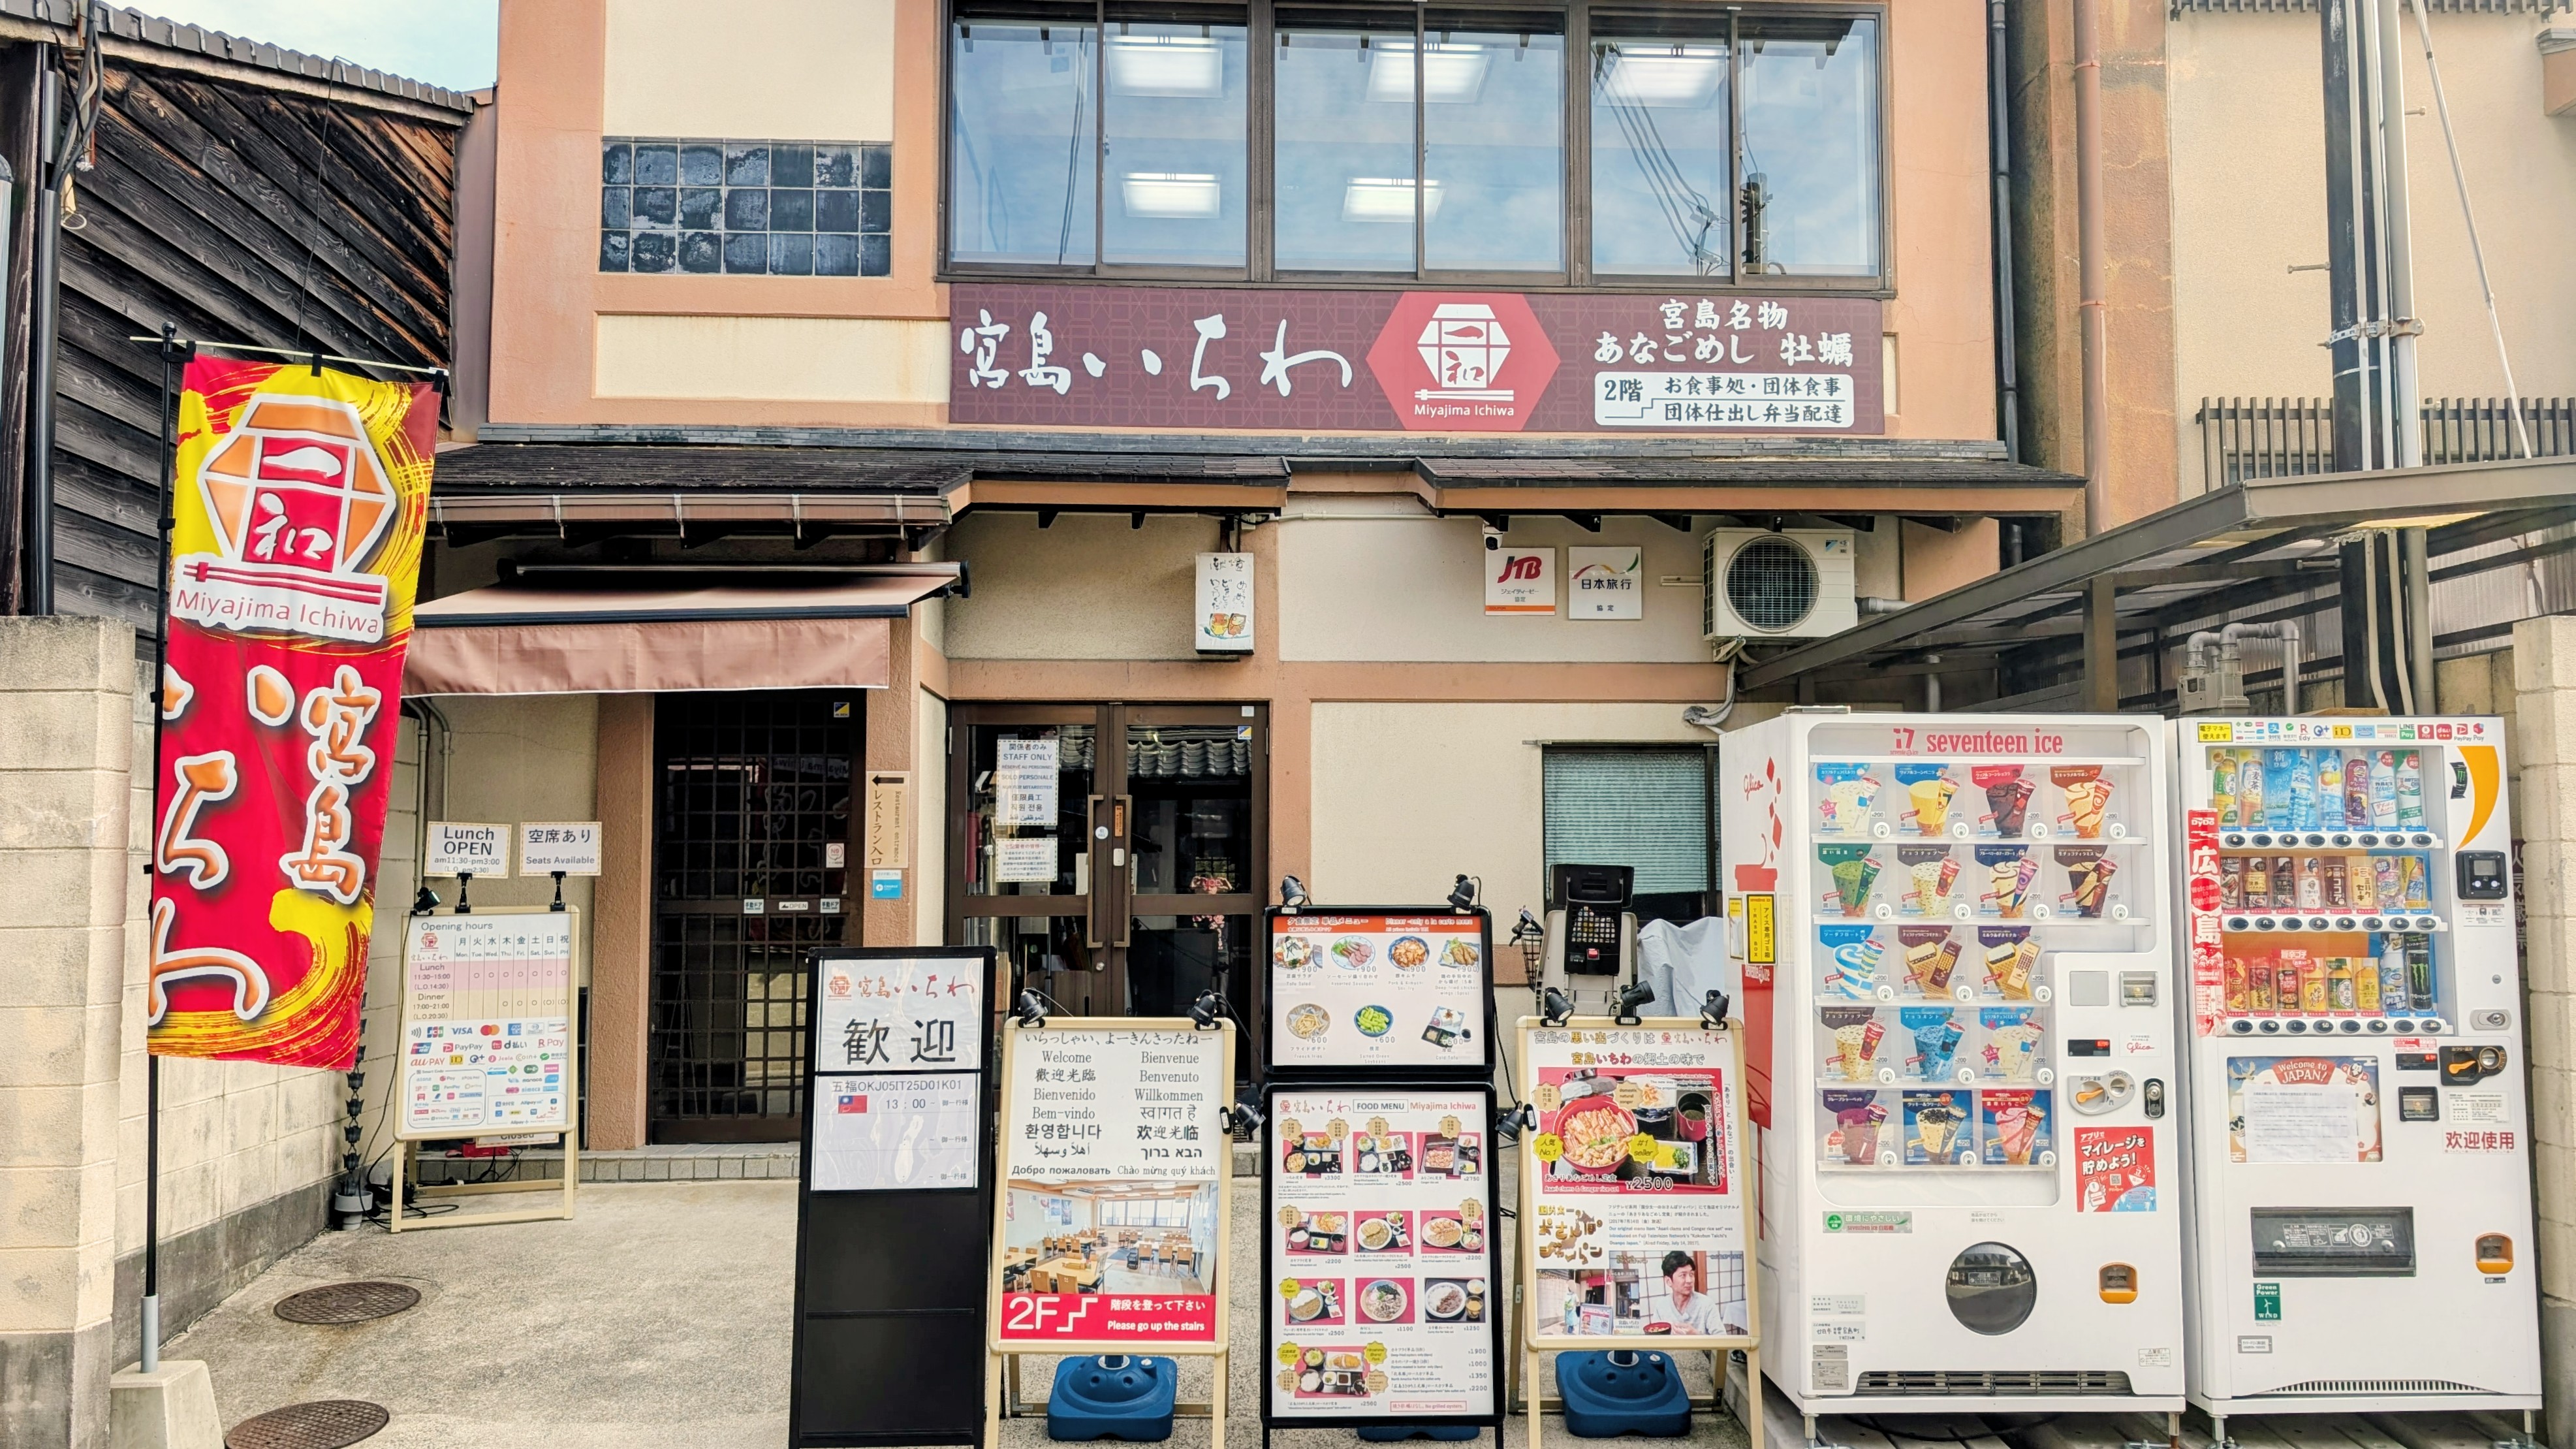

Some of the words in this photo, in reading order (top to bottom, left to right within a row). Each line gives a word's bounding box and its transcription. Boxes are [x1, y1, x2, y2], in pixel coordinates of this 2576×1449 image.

[1659, 299, 1789, 330] 宮島名物
[1595, 332, 1755, 364] あなごめし
[1780, 332, 1854, 366] 牡蠣
[1603, 379, 1643, 402] 2階
[1665, 377, 1842, 396] お食事処・団体食事
[1415, 405, 1470, 417] Miyajima
[1475, 404, 1515, 416] Ichiwa
[1663, 403, 1844, 423] 団体仕出し弁当配達
[1498, 556, 1542, 583] JTB
[1582, 579, 1632, 590] 日本旅行
[176, 589, 290, 621] Miyajima
[300, 603, 379, 634] Ichiwa
[1926, 730, 2027, 753] seventeen
[2035, 728, 2063, 754] ice
[1744, 773, 1763, 801] Glico
[870, 790, 883, 865] レストラン入口
[2191, 818, 2214, 826] DyDo
[444, 826, 494, 840] Lunch
[528, 829, 591, 843] 空席あり
[444, 841, 492, 855] OPEN
[421, 922, 462, 932] Opening
[465, 921, 493, 931] hours
[473, 937, 482, 946] 火
[488, 936, 497, 945] 水
[502, 936, 511, 945] 木
[517, 936, 526, 944] 金
[531, 936, 541, 944] 土
[547, 1038, 564, 1047] Pay
[842, 1018, 956, 1065] 歓迎
[1534, 1030, 1656, 1045] 宮島の思い出づくりは
[455, 1043, 483, 1051] PayPay
[2127, 1042, 2155, 1053] Glico
[1042, 1051, 1092, 1063] Welcome
[1141, 1051, 1199, 1064] Bienvenue
[1571, 1051, 1706, 1066] 宮島いちわの郷土の味で
[2278, 1062, 2316, 1072] Welcome
[2317, 1062, 2327, 1071] to
[1035, 1068, 1096, 1083] 歡迎光臨
[1139, 1070, 1199, 1083] Benvenuto
[2282, 1069, 2328, 1084] JAPAN!
[1033, 1088, 1096, 1100] Bienvenido
[1135, 1089, 1204, 1101] Willkommen
[1032, 1107, 1095, 1119] Bem-vindo
[1140, 1107, 1183, 1121] स्वागत
[1187, 1104, 1197, 1122] है
[1410, 1102, 1448, 1111] Miyajima
[1450, 1102, 1476, 1110] Ichiwa
[1025, 1123, 1102, 1140] 환영합니다
[1137, 1125, 1199, 1141] 欢迎光临
[2081, 1134, 2146, 1158] マイレージを
[2445, 1131, 2515, 1149] 欢迎使用
[1141, 1148, 1170, 1160] ברוך
[1175, 1149, 1202, 1158] הבא
[1012, 1165, 1045, 1176] Добро
[1049, 1166, 1111, 1175] пожаловать
[1117, 1165, 1140, 1175] Chào
[1170, 1165, 1187, 1177] quý
[1190, 1165, 1216, 1176] khách
[1845, 1214, 1900, 1222] 環境にやさしい
[1110, 1299, 1206, 1313] 階段を登って下さい
[1007, 1296, 1060, 1331] 2F
[1107, 1320, 1137, 1331] Please
[1137, 1322, 1149, 1332] go
[1150, 1322, 1163, 1332] up
[1163, 1320, 1179, 1331] the
[1180, 1320, 1205, 1331] stairs
